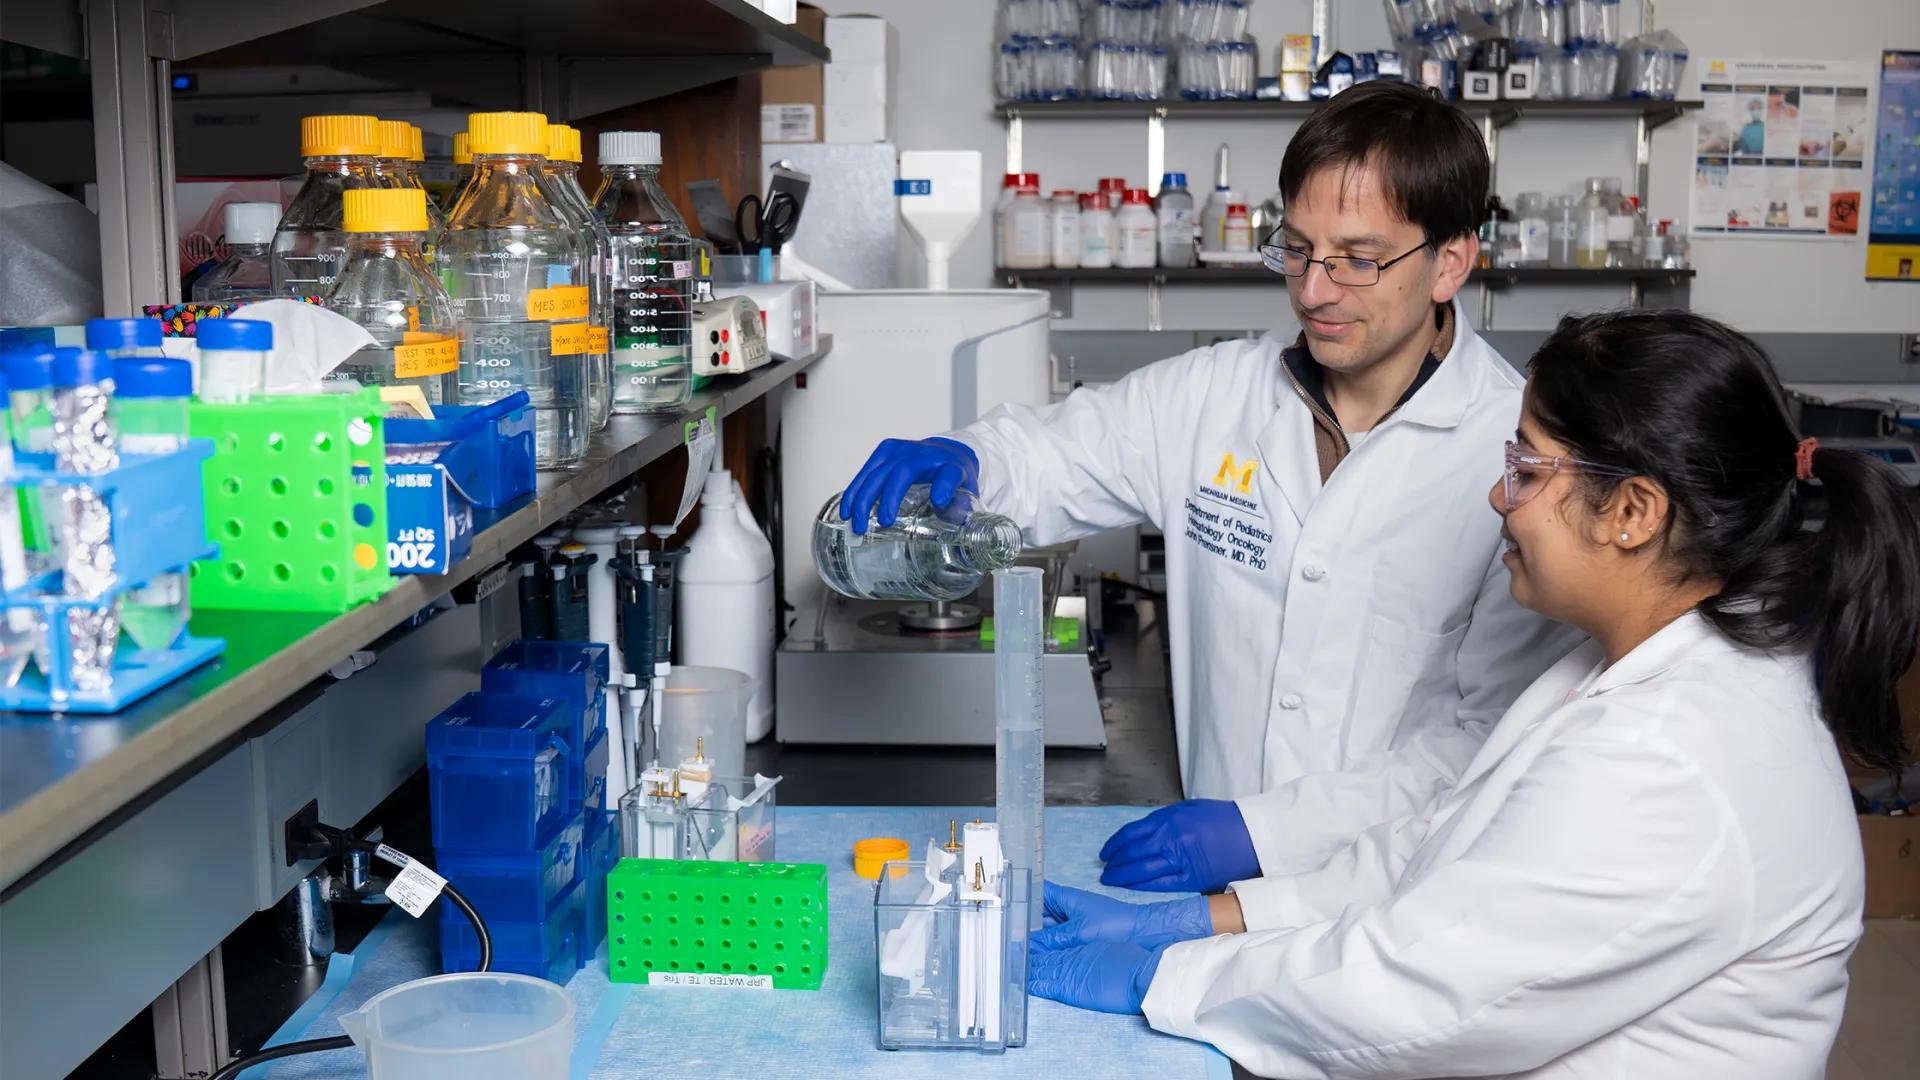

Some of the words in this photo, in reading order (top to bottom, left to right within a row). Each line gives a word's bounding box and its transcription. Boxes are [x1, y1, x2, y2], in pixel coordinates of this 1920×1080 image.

[317, 254, 336, 262] 900
[319, 277, 337, 285] 800
[493, 293, 511, 303] 700
[533, 300, 556, 313] MES
[474, 336, 510, 345] 500
[474, 358, 511, 367] 400
[336, 372, 350, 381] 300
[476, 380, 511, 389] 300
[1212, 452, 1259, 495] M
[1199, 485, 1228, 501] MICHIGAN
[1229, 495, 1258, 511] MEDICINE
[1184, 498, 1219, 523] Department
[1223, 517, 1233, 528] of
[1235, 520, 1273, 543] Pediatrics
[397, 529, 414, 541] FT
[415, 527, 435, 542] SQ
[1188, 513, 1224, 542] Hematology
[1227, 532, 1265, 557] Oncology
[1185, 527, 1197, 540] John
[1231, 549, 1246, 564] MD,
[1249, 556, 1267, 571] PhD
[387, 542, 435, 568] 200
[664, 975, 679, 984] Tris
[688, 976, 702, 985] TE
[709, 976, 746, 986] WATER
[747, 977, 766, 987] JRP
